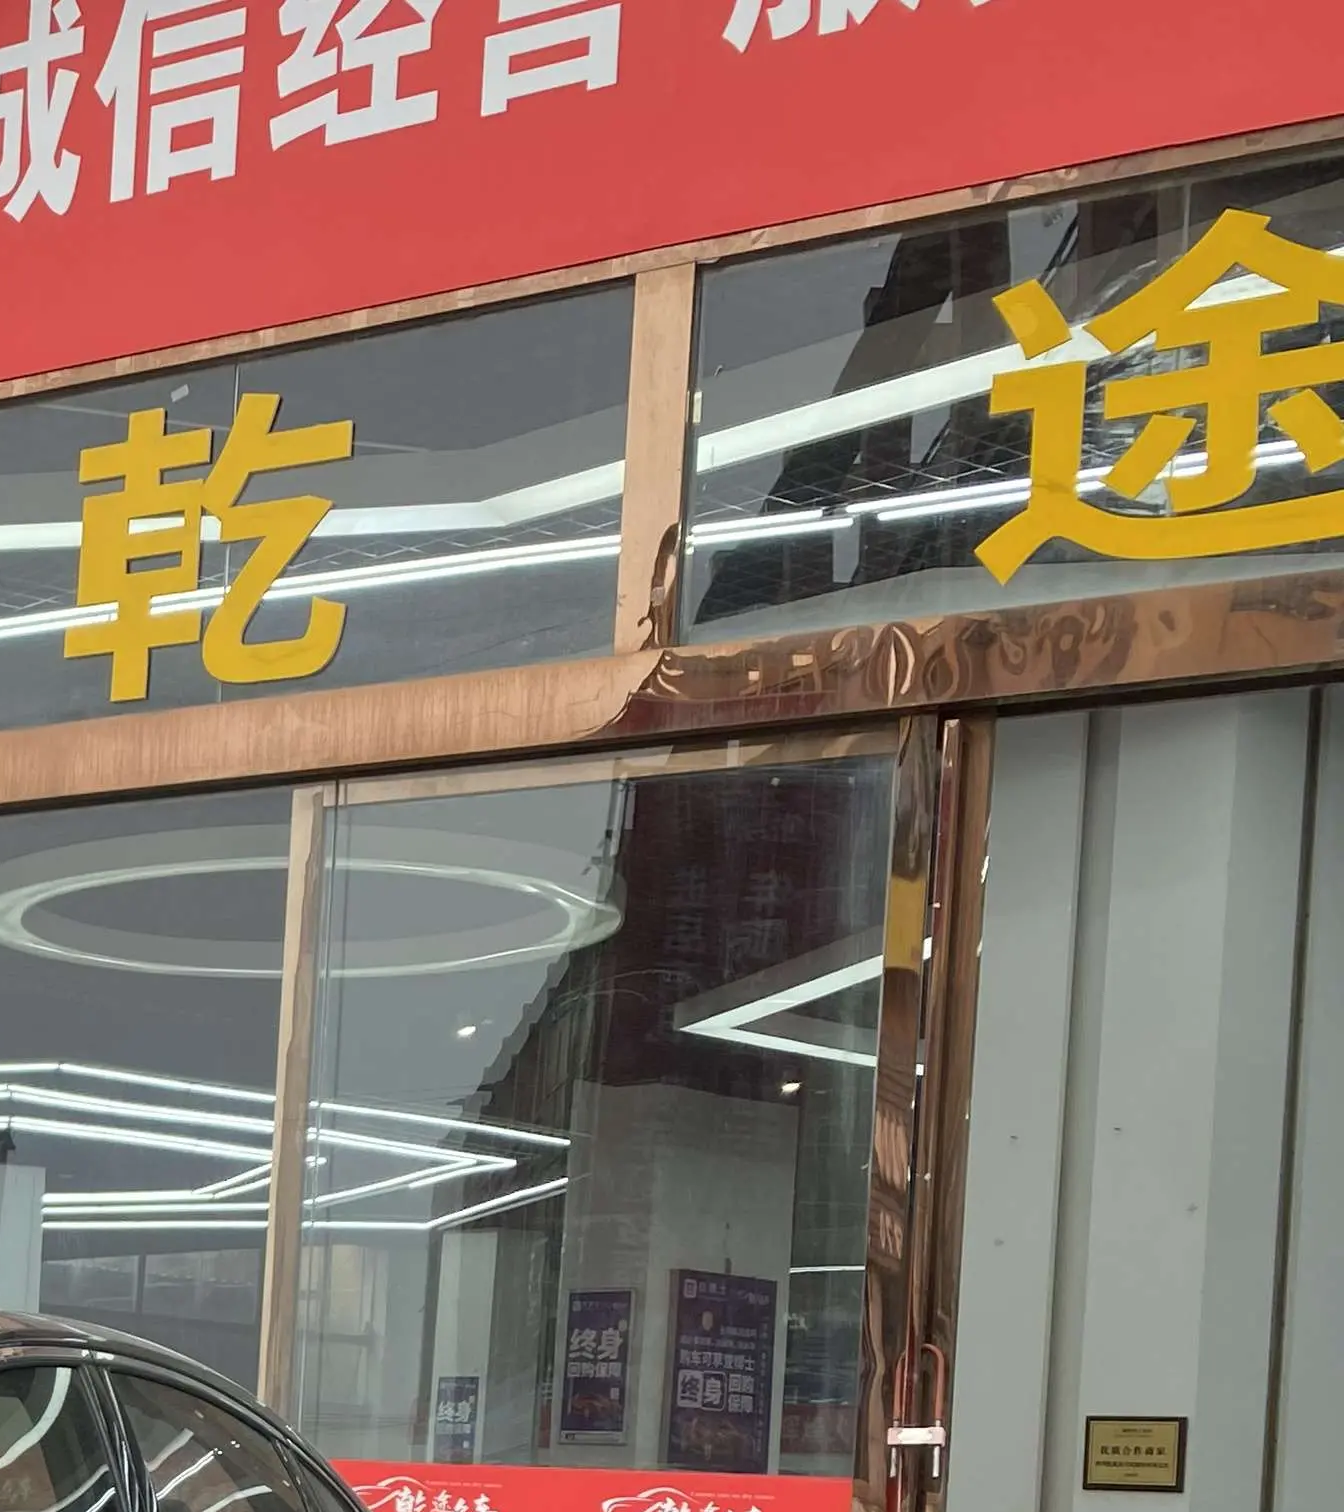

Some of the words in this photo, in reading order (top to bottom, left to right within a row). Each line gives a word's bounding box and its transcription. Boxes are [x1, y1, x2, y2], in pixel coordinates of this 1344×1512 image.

[568, 1327, 624, 1361] 终身
[566, 1361, 622, 1379] 回购保障
[678, 1372, 724, 1407] 终身
